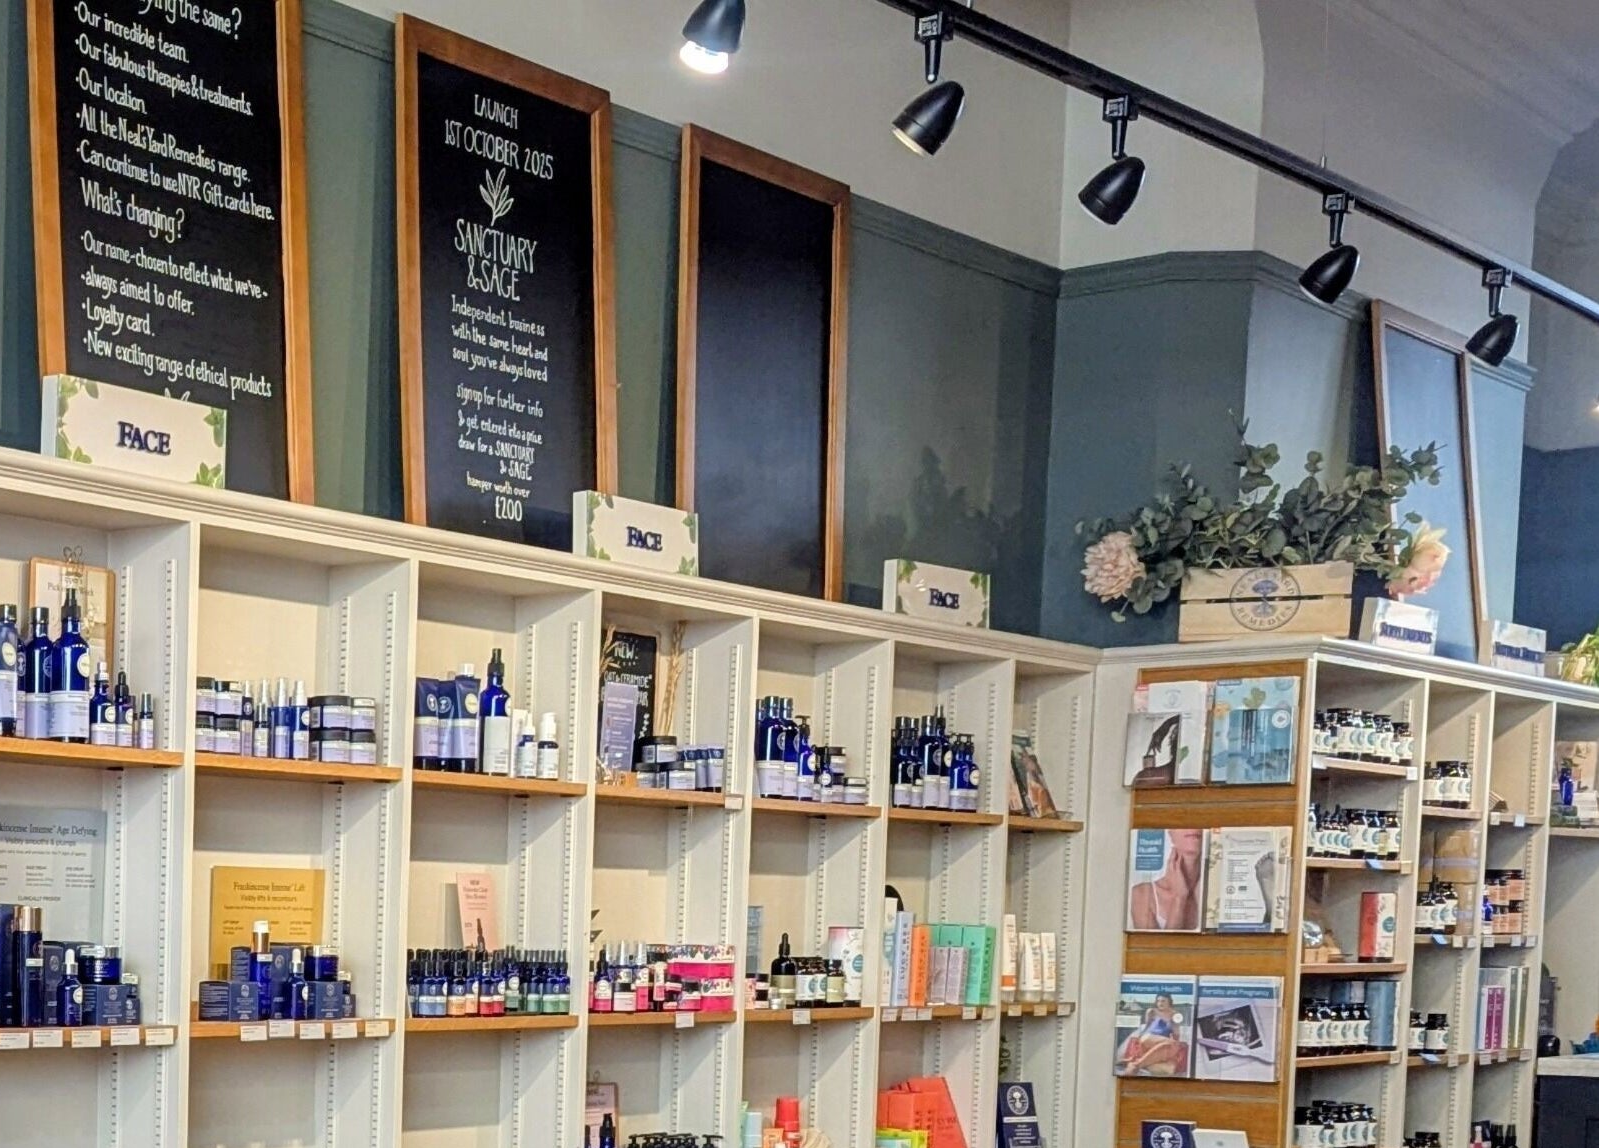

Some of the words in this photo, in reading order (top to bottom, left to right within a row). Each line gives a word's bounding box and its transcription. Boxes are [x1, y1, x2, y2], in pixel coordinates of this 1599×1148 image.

[180, 0, 199, 23] the
[78, 1, 101, 27] Our
[104, 13, 155, 49] incredible
[158, 32, 189, 63] team.
[79, 33, 101, 60] Our
[103, 43, 146, 78] fabulous
[148, 60, 190, 98] therapies
[79, 68, 102, 97] Our
[104, 77, 147, 114] location.
[474, 94, 518, 129] LAUNCH
[80, 104, 96, 132] All
[100, 110, 117, 138] the
[119, 117, 146, 150] Neal's
[145, 126, 167, 157] Yard
[168, 134, 216, 172] Remedies
[218, 162, 250, 188] range.
[445, 119, 462, 148] 1ST
[464, 126, 519, 170] OCTOBER
[524, 148, 553, 179] 2025
[80, 139, 105, 168] Can
[106, 154, 148, 183] continue
[150, 163, 160, 186] to
[163, 177, 178, 192] use
[178, 173, 201, 199] NYR
[203, 182, 224, 207] Gift
[225, 195, 250, 214] cards
[250, 193, 275, 220] here.
[80, 177, 121, 217] What's
[127, 194, 185, 243] changing?
[84, 230, 104, 256] Our
[169, 256, 178, 277] to
[180, 263, 209, 287] reflect
[210, 269, 233, 292] what
[455, 218, 537, 274] SANCTUARY
[120, 278, 150, 303] aimed
[154, 284, 164, 306] to
[167, 290, 195, 315] offer.
[478, 260, 520, 301] SAGE
[86, 297, 124, 335] Loyalty
[451, 294, 506, 326] Independent
[508, 312, 544, 336] business
[452, 323, 471, 340] with
[473, 326, 486, 345] the
[489, 335, 510, 351] same
[512, 335, 533, 358] heart
[534, 348, 548, 361] and
[87, 330, 112, 357] New
[115, 344, 154, 376] exciting
[155, 355, 183, 382] range
[185, 359, 196, 378] of
[196, 362, 228, 388] ethical
[230, 373, 271, 400] products
[453, 347, 469, 362] soul
[468, 353, 497, 370] you've
[499, 355, 523, 382] always
[524, 360, 547, 382] loved
[484, 386, 495, 405] for
[528, 400, 543, 417] info
[117, 421, 171, 456] FACE
[481, 418, 506, 436] entered
[458, 434, 475, 450] draw
[478, 437, 488, 453] for
[495, 440, 535, 464] SANCTUARY
[508, 460, 532, 480] SAGE
[495, 496, 522, 522] £200
[626, 525, 663, 551] FACE
[929, 587, 959, 609] FACE
[71, 826, 98, 836] Defying
